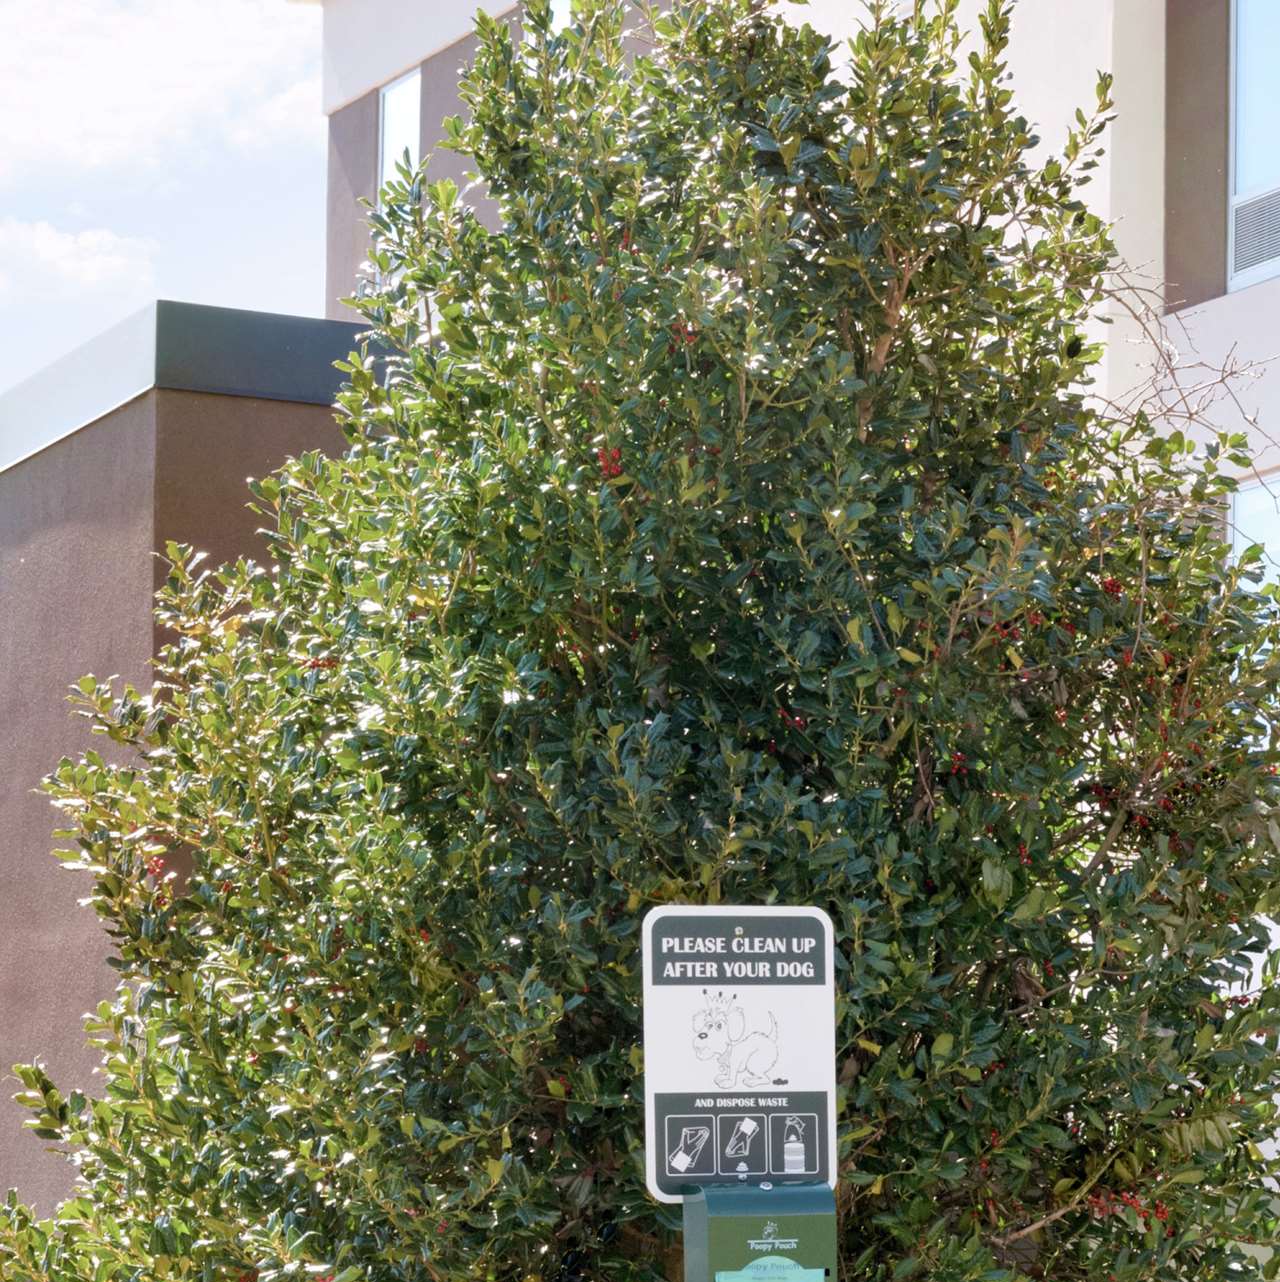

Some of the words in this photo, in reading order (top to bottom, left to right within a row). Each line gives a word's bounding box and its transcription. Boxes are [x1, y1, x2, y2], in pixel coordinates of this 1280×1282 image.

[661, 937, 727, 953] PLEASE
[731, 937, 786, 953] CLEAN
[791, 937, 816, 953] UP
[663, 961, 718, 978] AFTER
[723, 961, 771, 977] YOUR
[776, 961, 815, 977] DOG
[694, 1098, 714, 1108] AND
[716, 1097, 757, 1108] DISPOSE
[758, 1097, 789, 1107] WASTE
